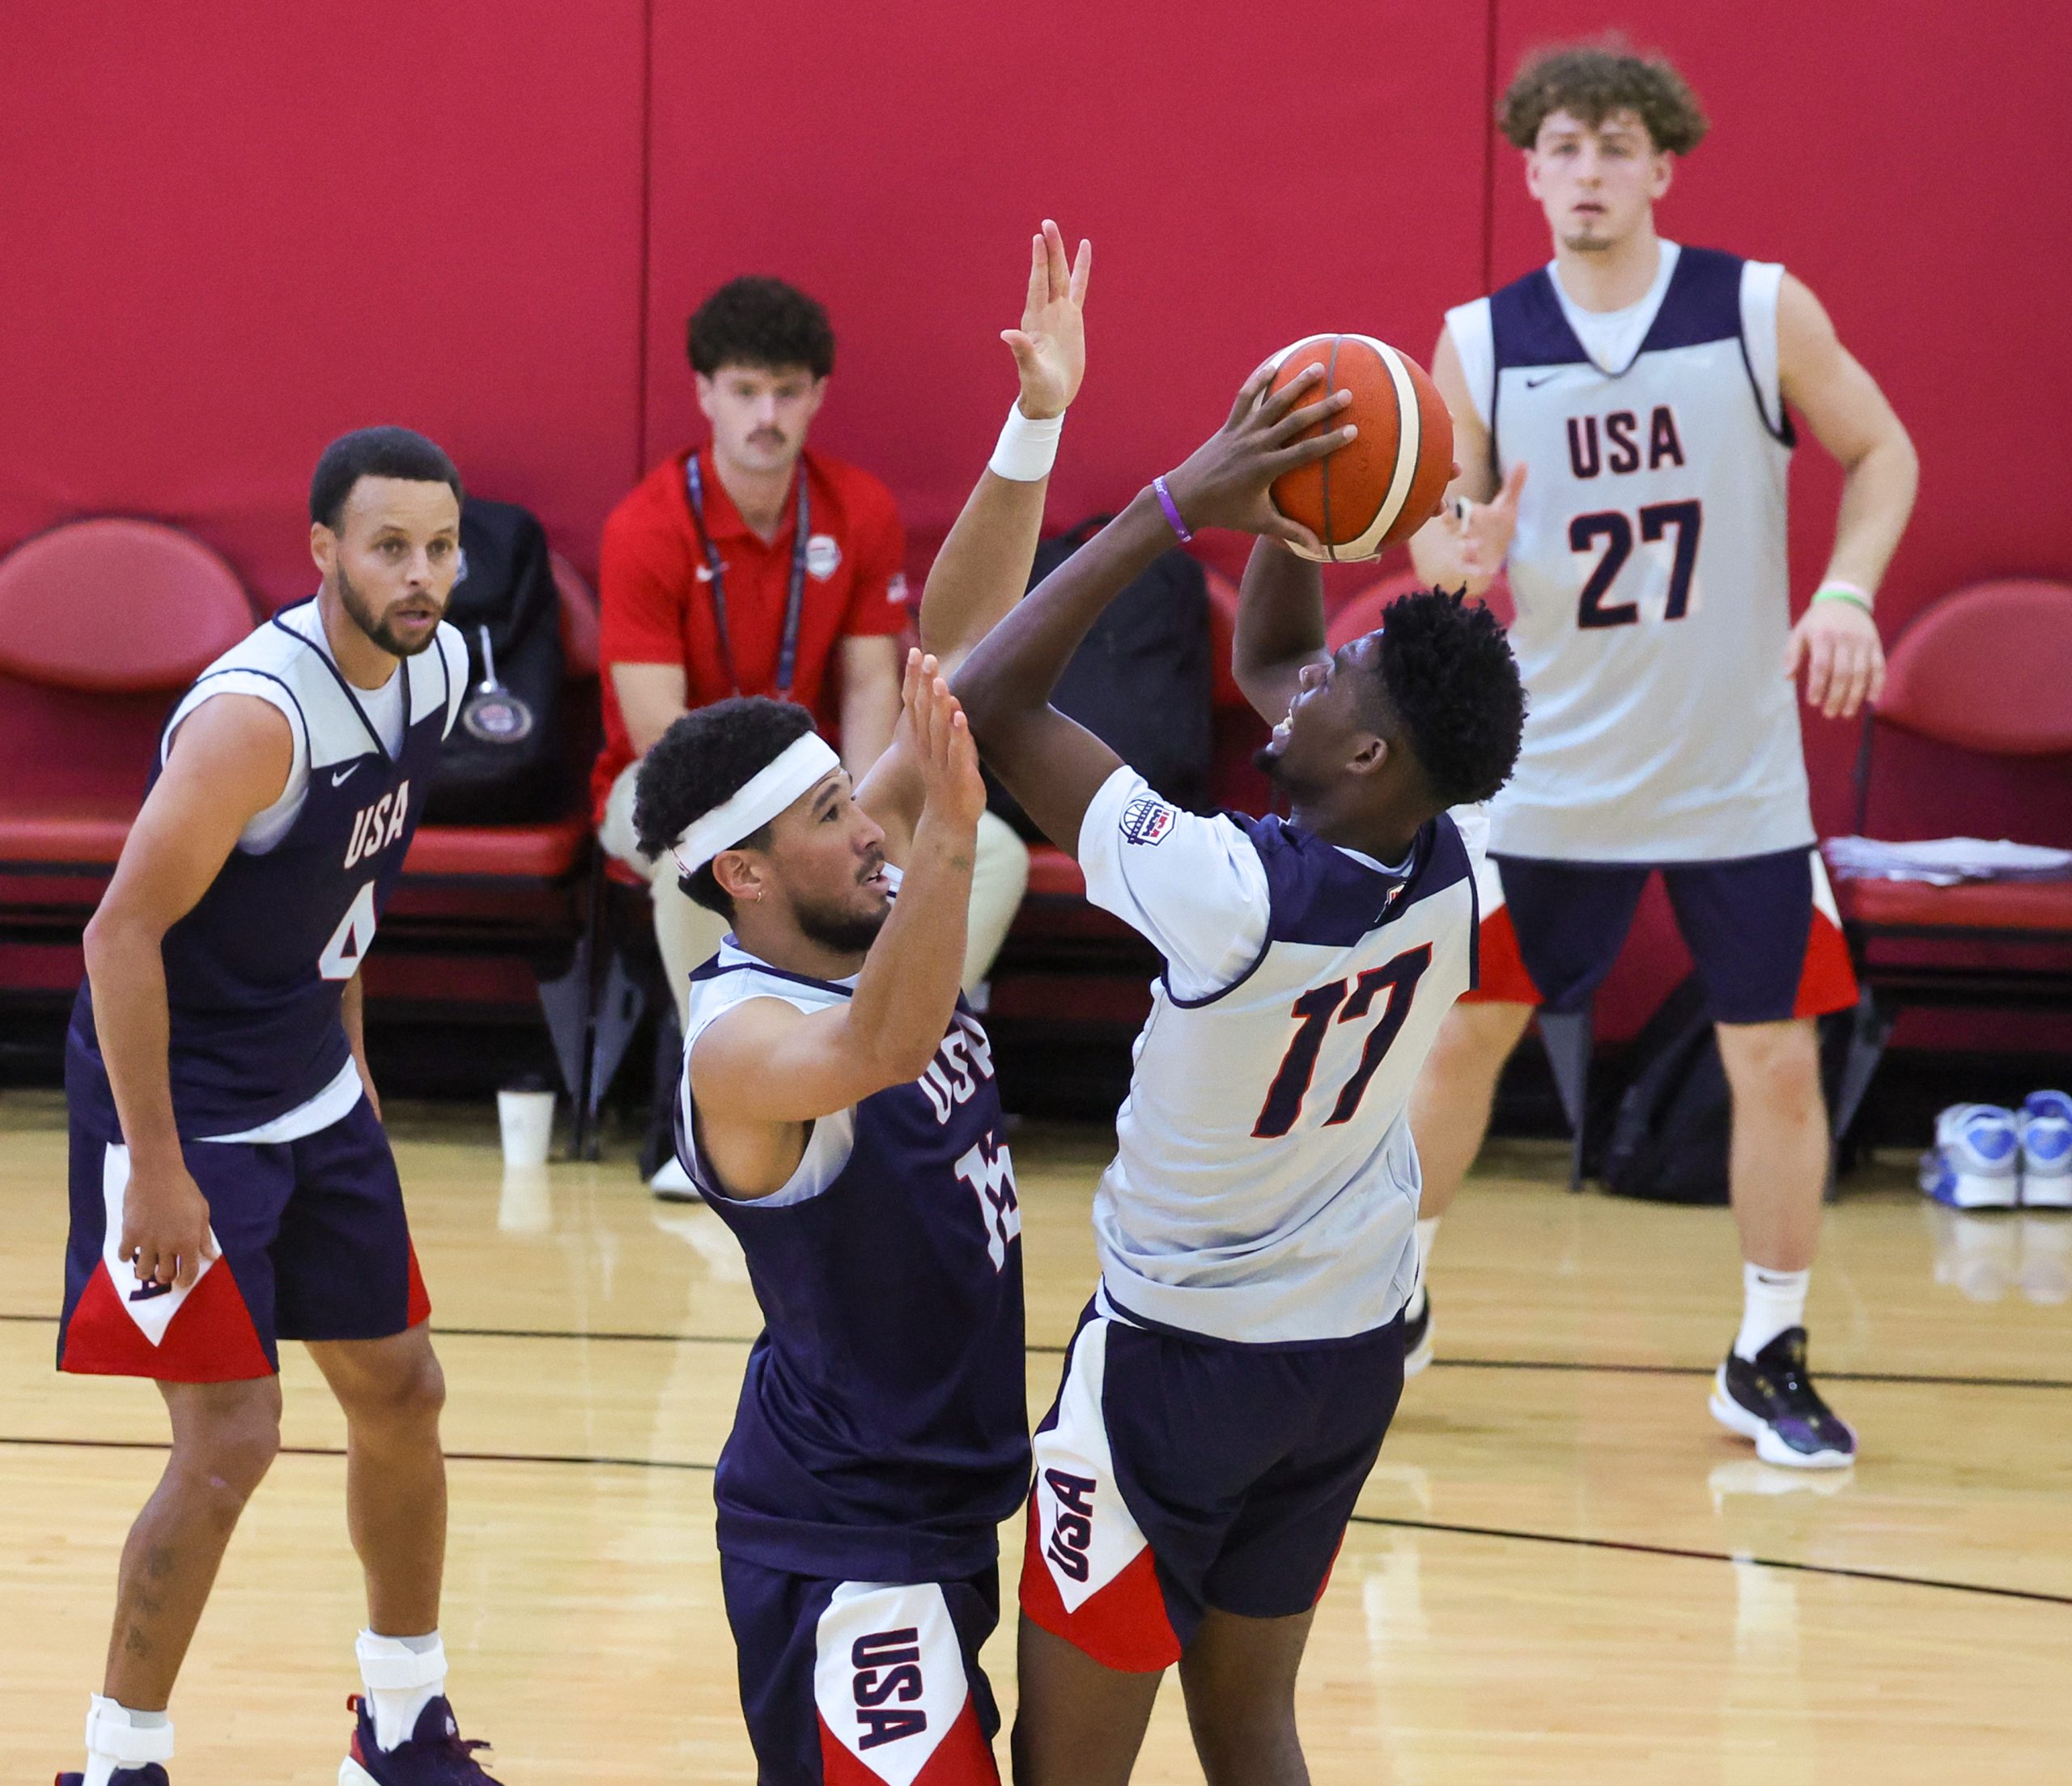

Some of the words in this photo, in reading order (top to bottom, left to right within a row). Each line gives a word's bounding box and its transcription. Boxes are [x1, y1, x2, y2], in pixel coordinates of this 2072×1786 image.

[1565, 405, 1684, 478] USA
[1569, 498, 1702, 630] 27
[344, 779, 409, 870] USA
[318, 879, 376, 980] 4
[1250, 941, 1433, 1139] 17
[1045, 1467, 1097, 1583] USA
[851, 1627, 928, 1751] USA
